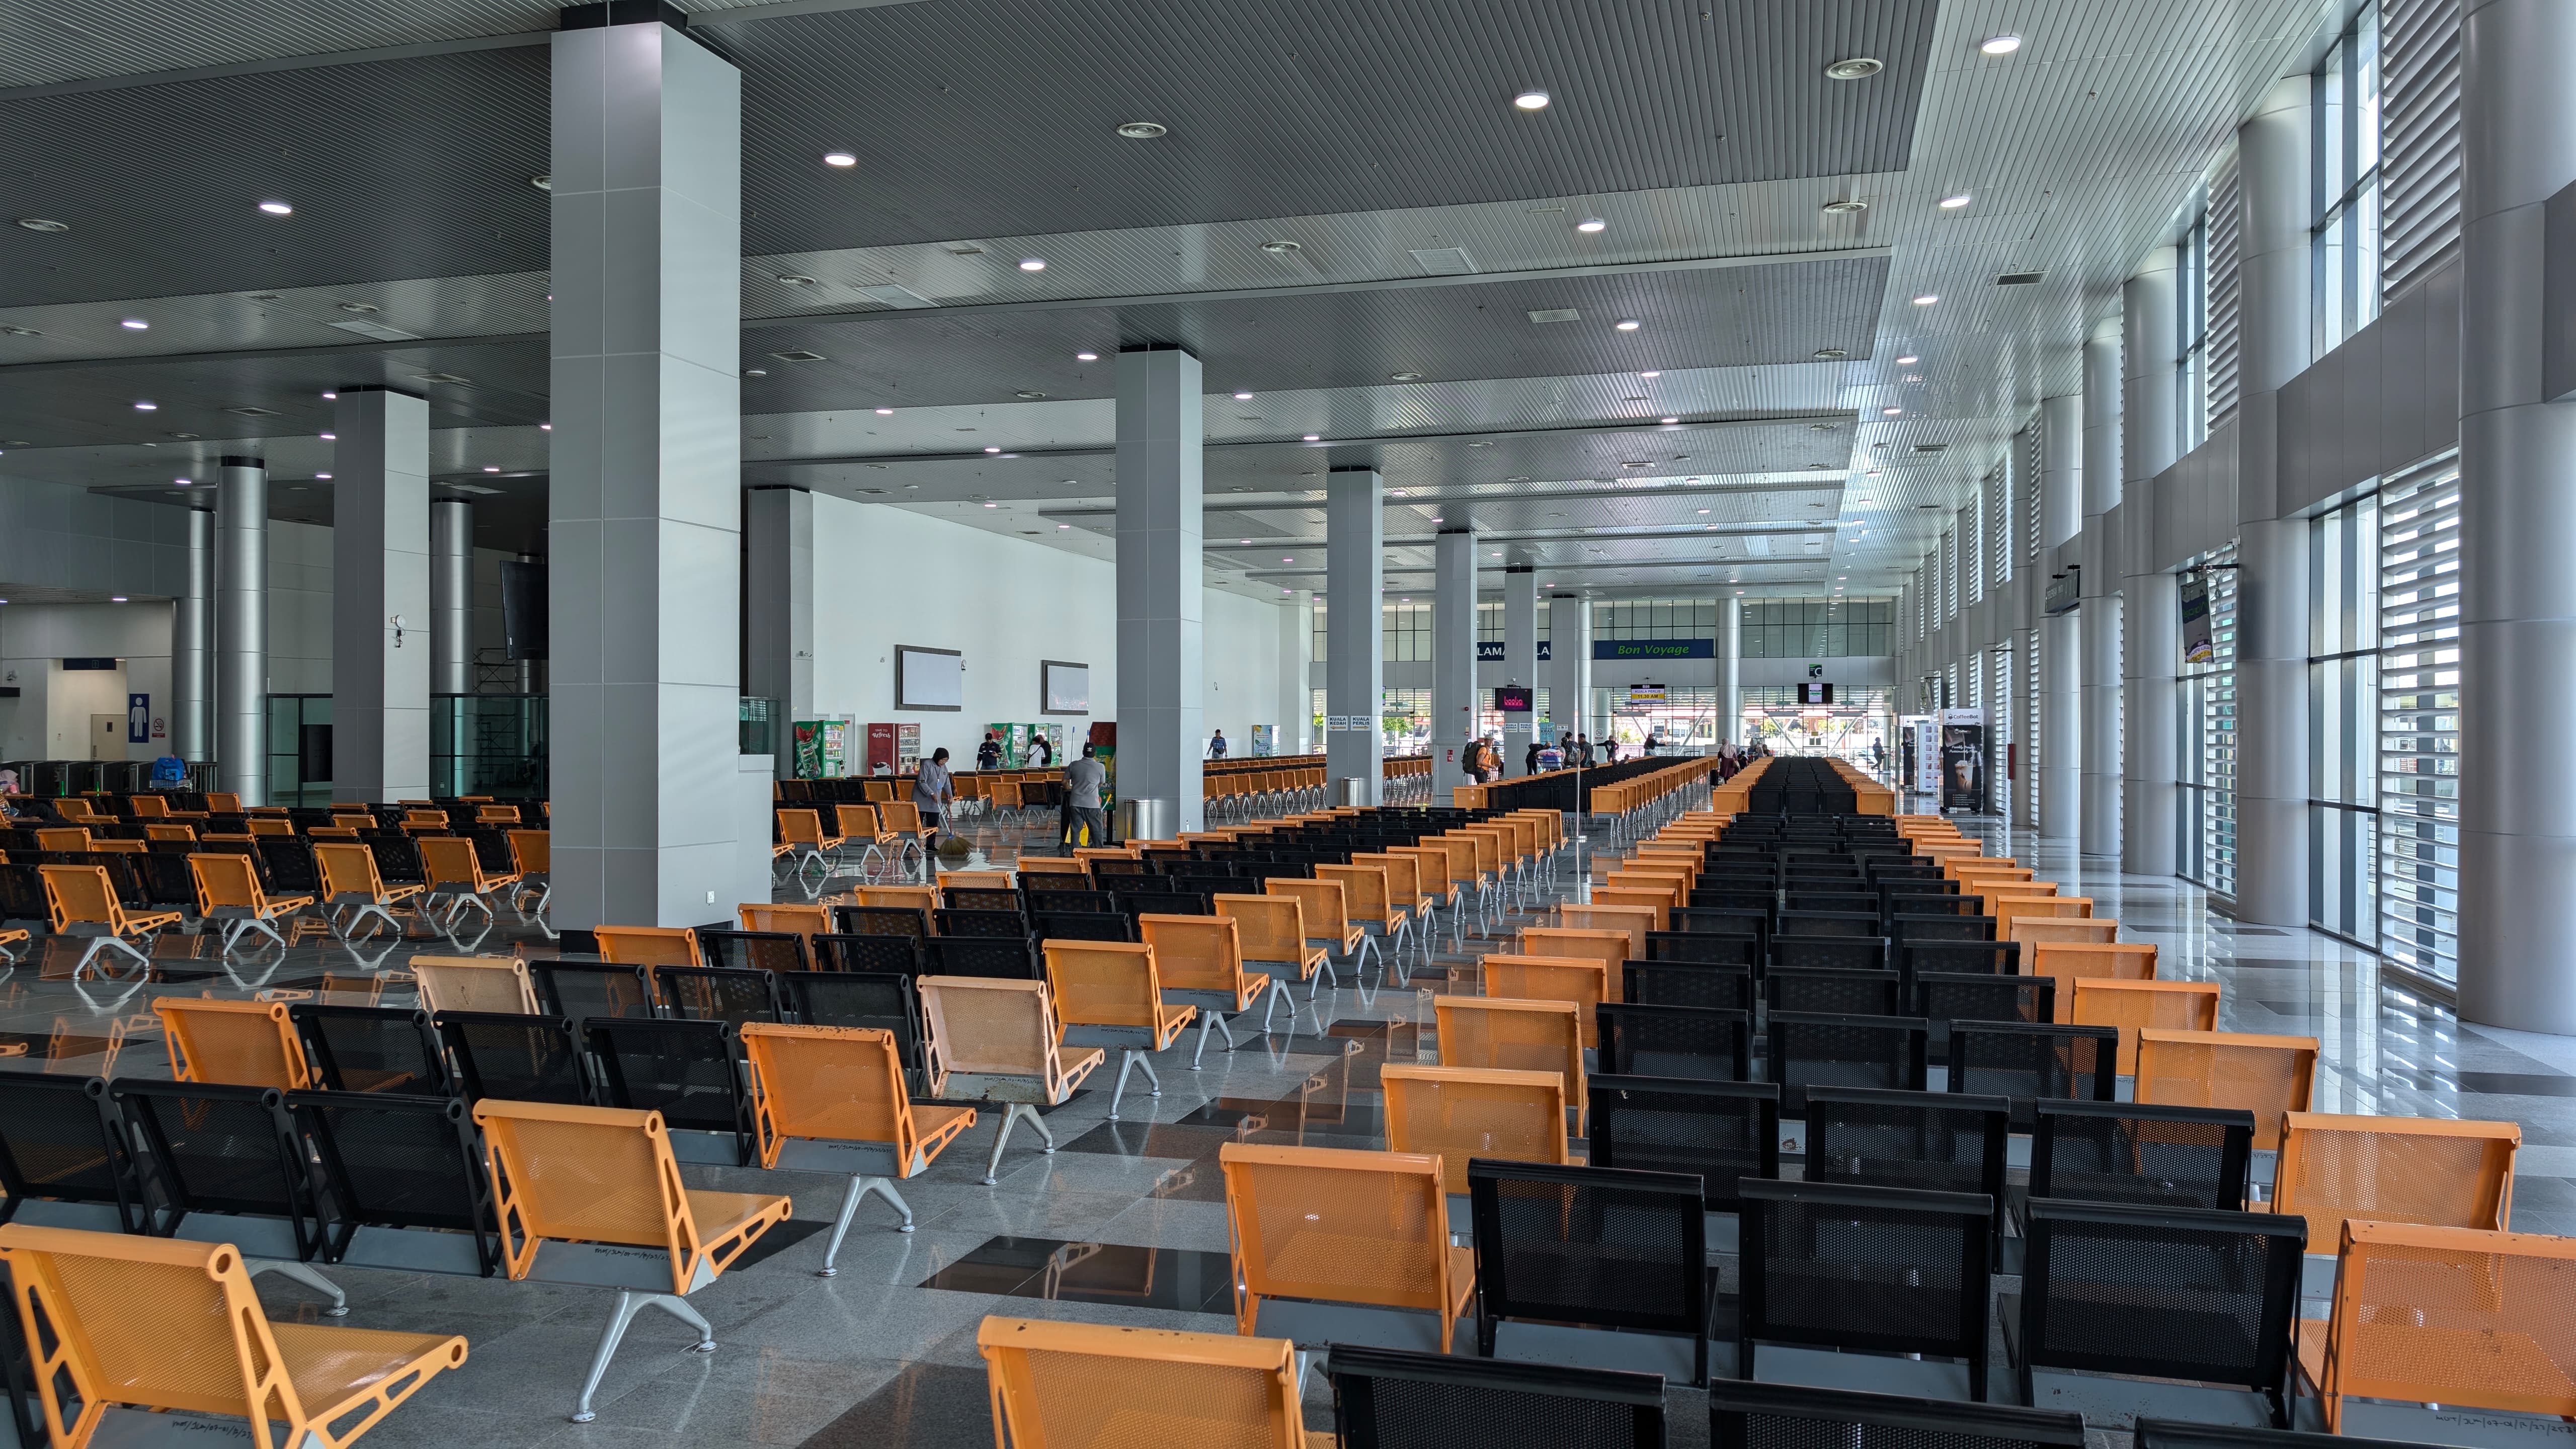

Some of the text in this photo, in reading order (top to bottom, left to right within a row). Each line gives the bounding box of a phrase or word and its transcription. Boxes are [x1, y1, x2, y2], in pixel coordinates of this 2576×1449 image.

[1618, 645, 1689, 656] Bon Voyage
[1815, 667, 1822, 676] C
